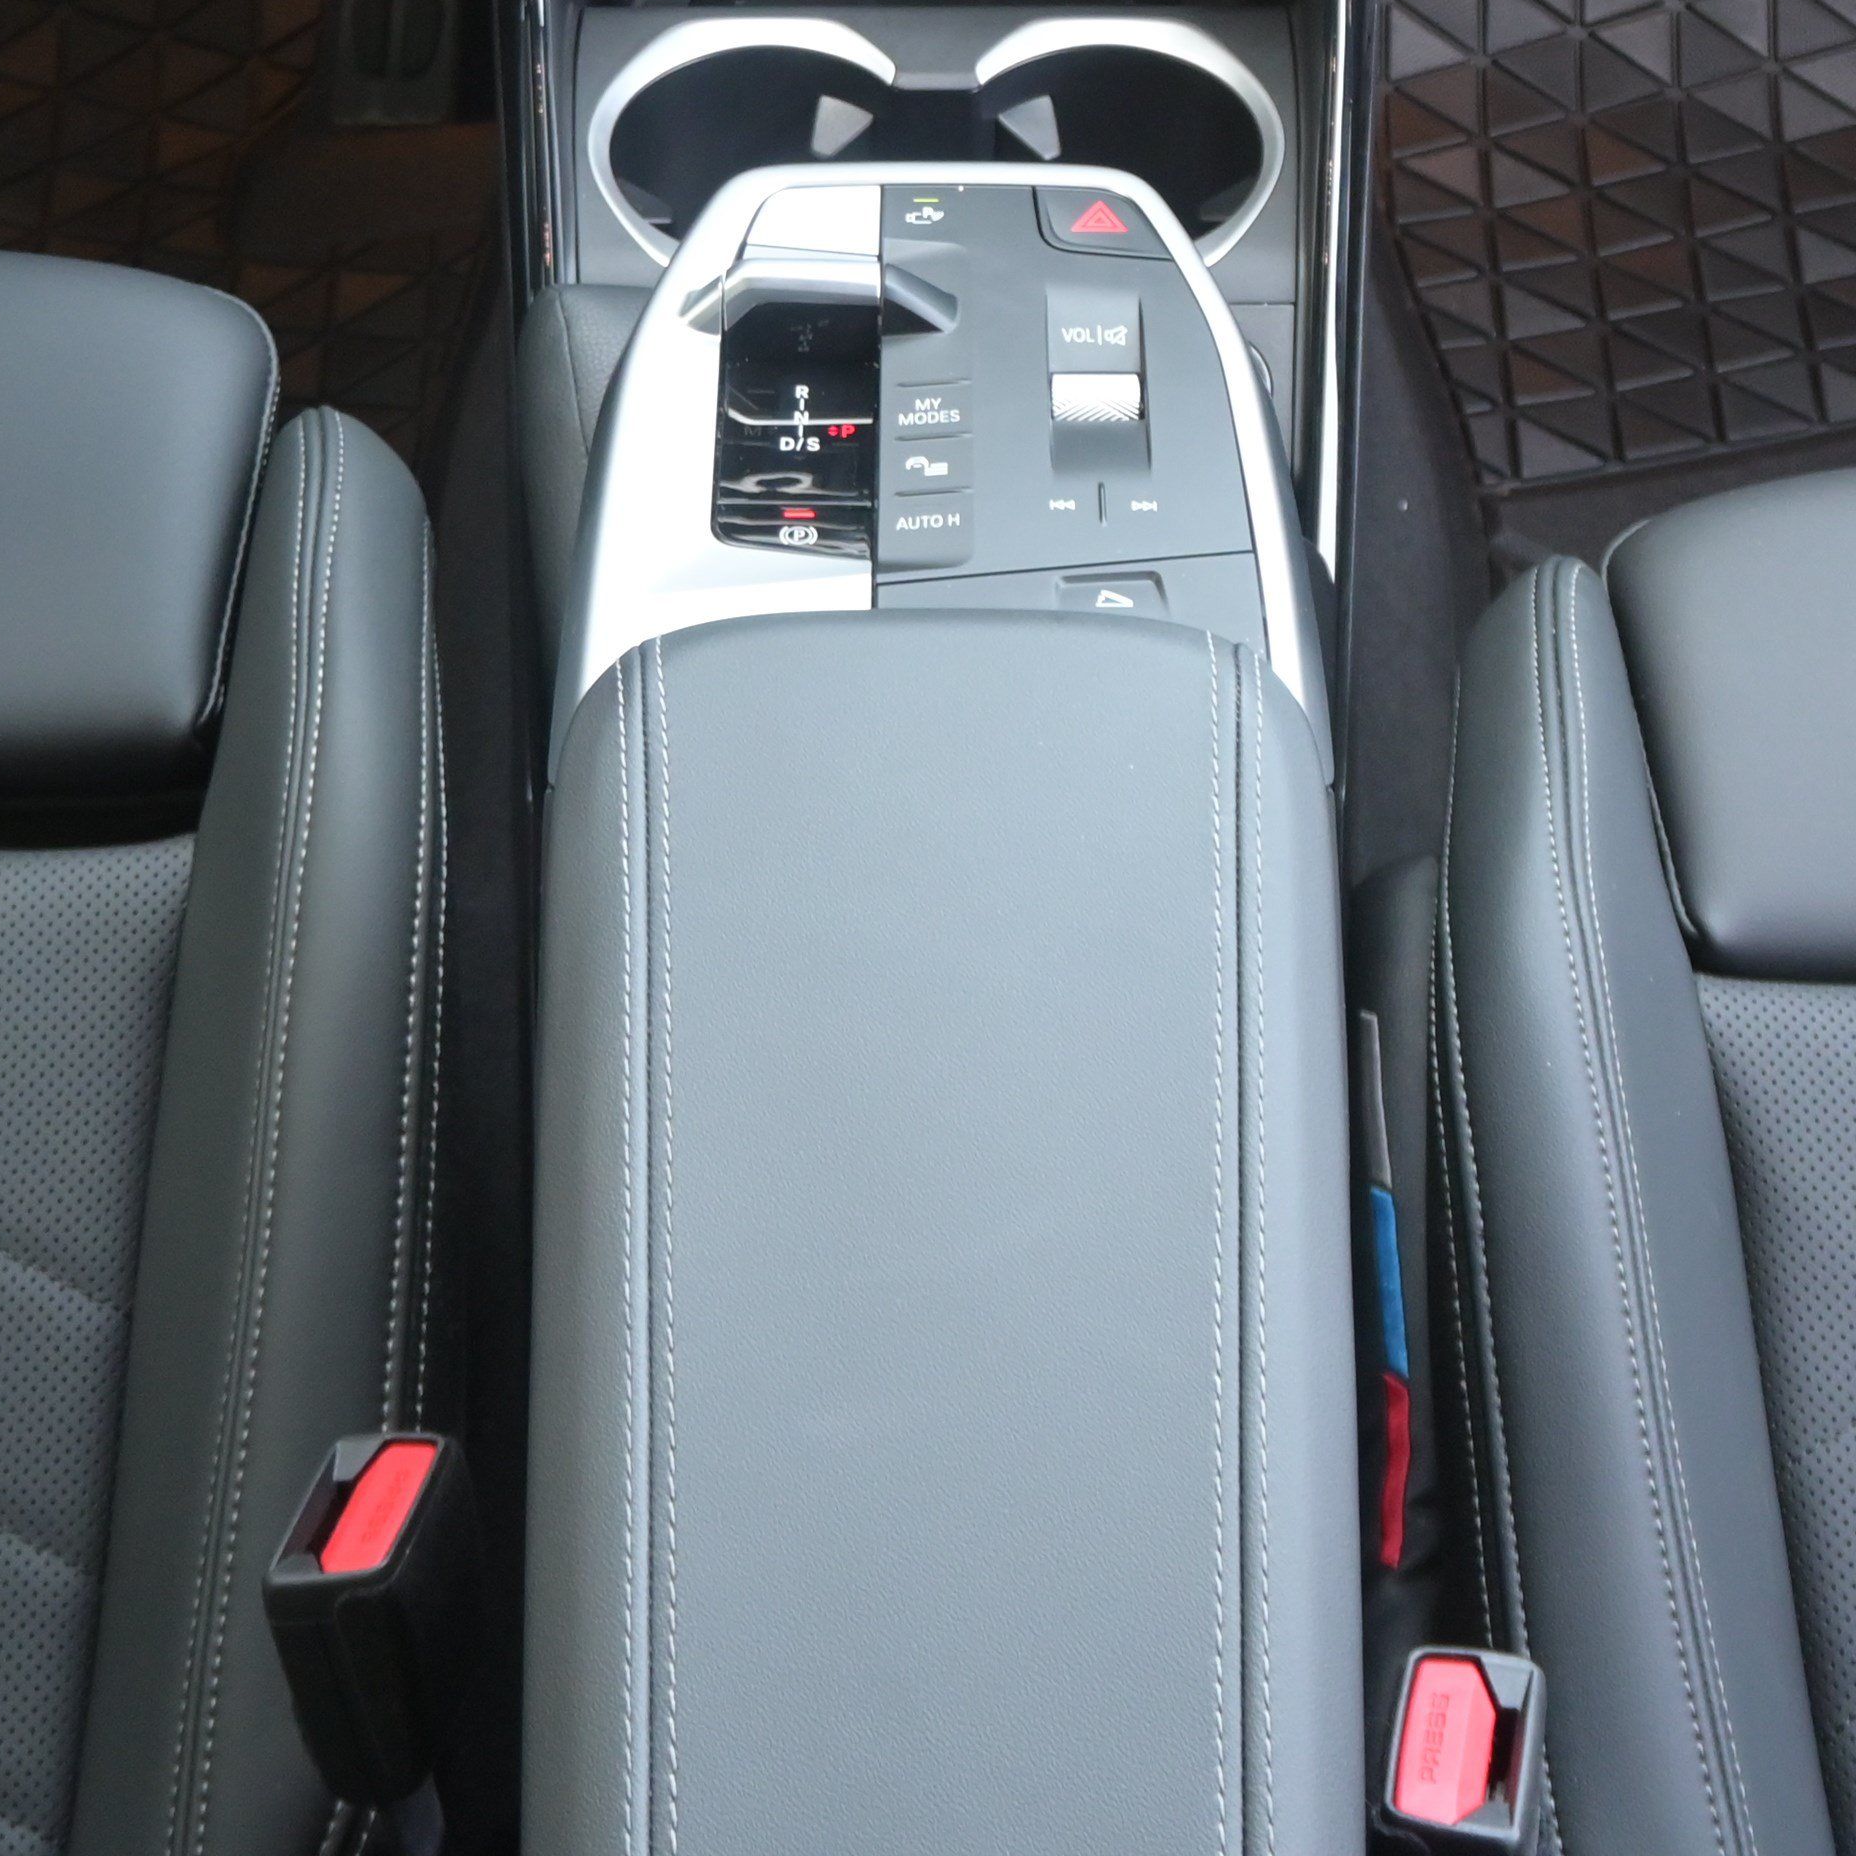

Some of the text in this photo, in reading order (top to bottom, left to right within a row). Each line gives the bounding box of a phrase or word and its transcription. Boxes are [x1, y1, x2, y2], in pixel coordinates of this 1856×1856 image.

[1061, 328, 1095, 344] VOL
[795, 385, 809, 399] R
[915, 398, 941, 411] MY
[794, 411, 809, 425] N
[898, 410, 960, 426] MODES
[841, 424, 856, 438] P
[896, 513, 960, 531] AUTO H
[1418, 1692, 1450, 1784] PRESS
